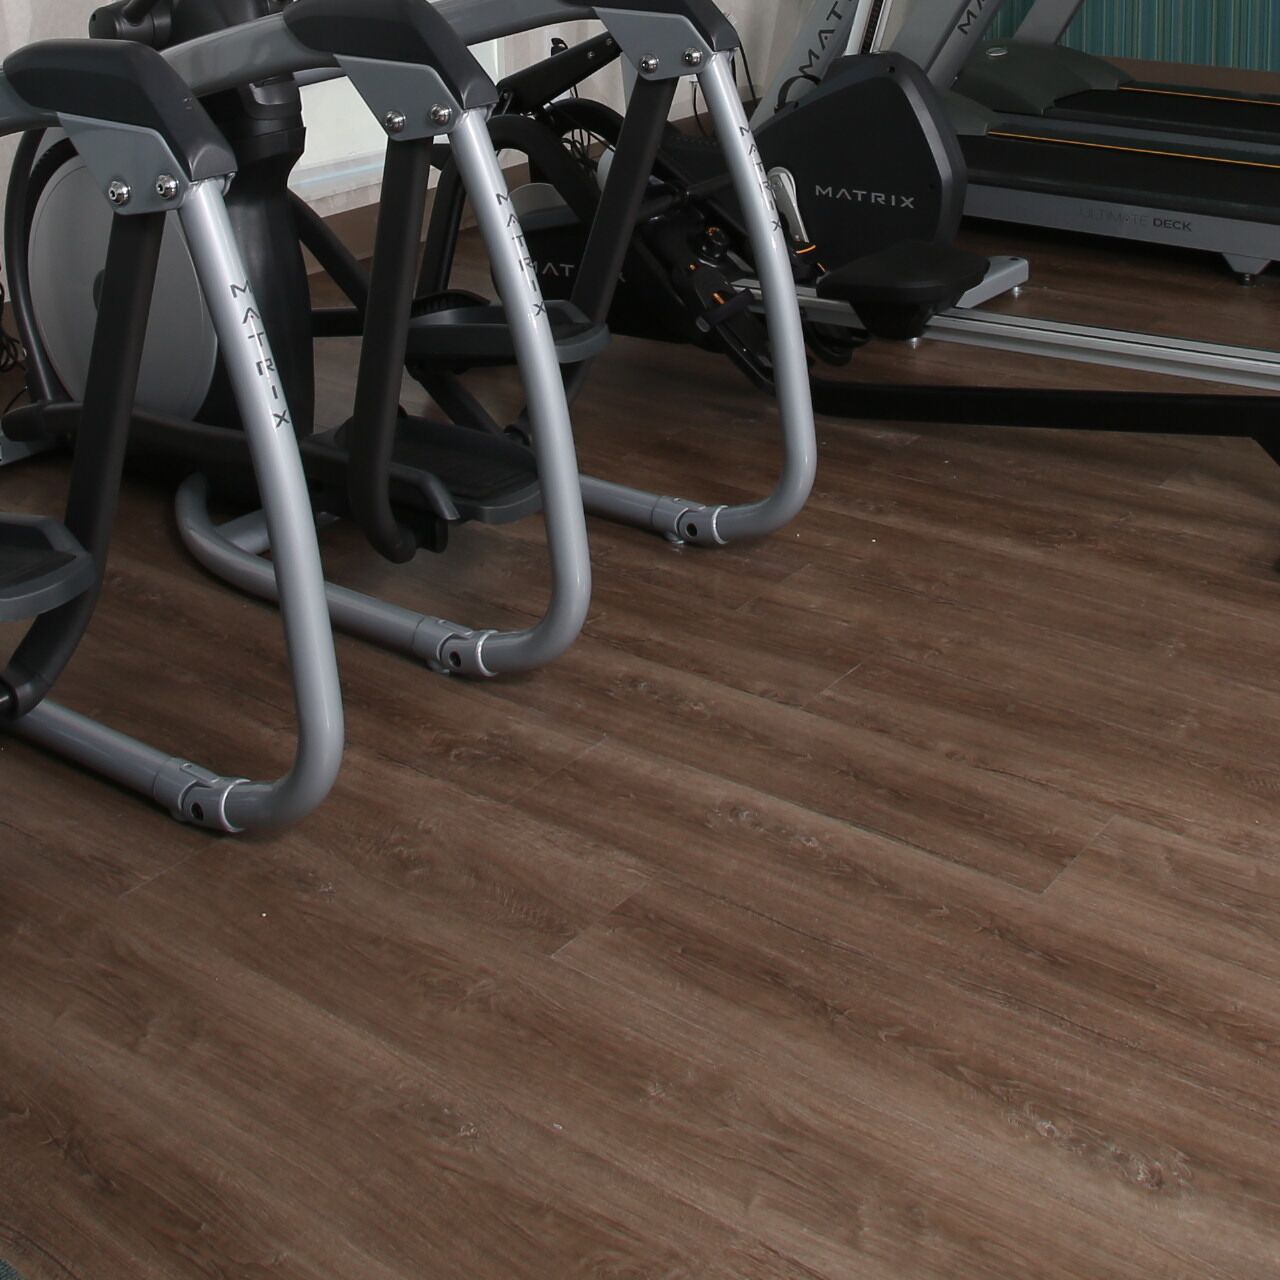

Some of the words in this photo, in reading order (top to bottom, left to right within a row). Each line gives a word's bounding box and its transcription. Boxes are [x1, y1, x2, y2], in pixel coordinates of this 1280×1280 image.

[740, 126, 782, 231] MATRIX
[816, 185, 914, 208] MATRIX
[1153, 218, 1192, 232] DECK
[496, 193, 546, 316] MATRIX
[230, 280, 290, 428] MATRIX
